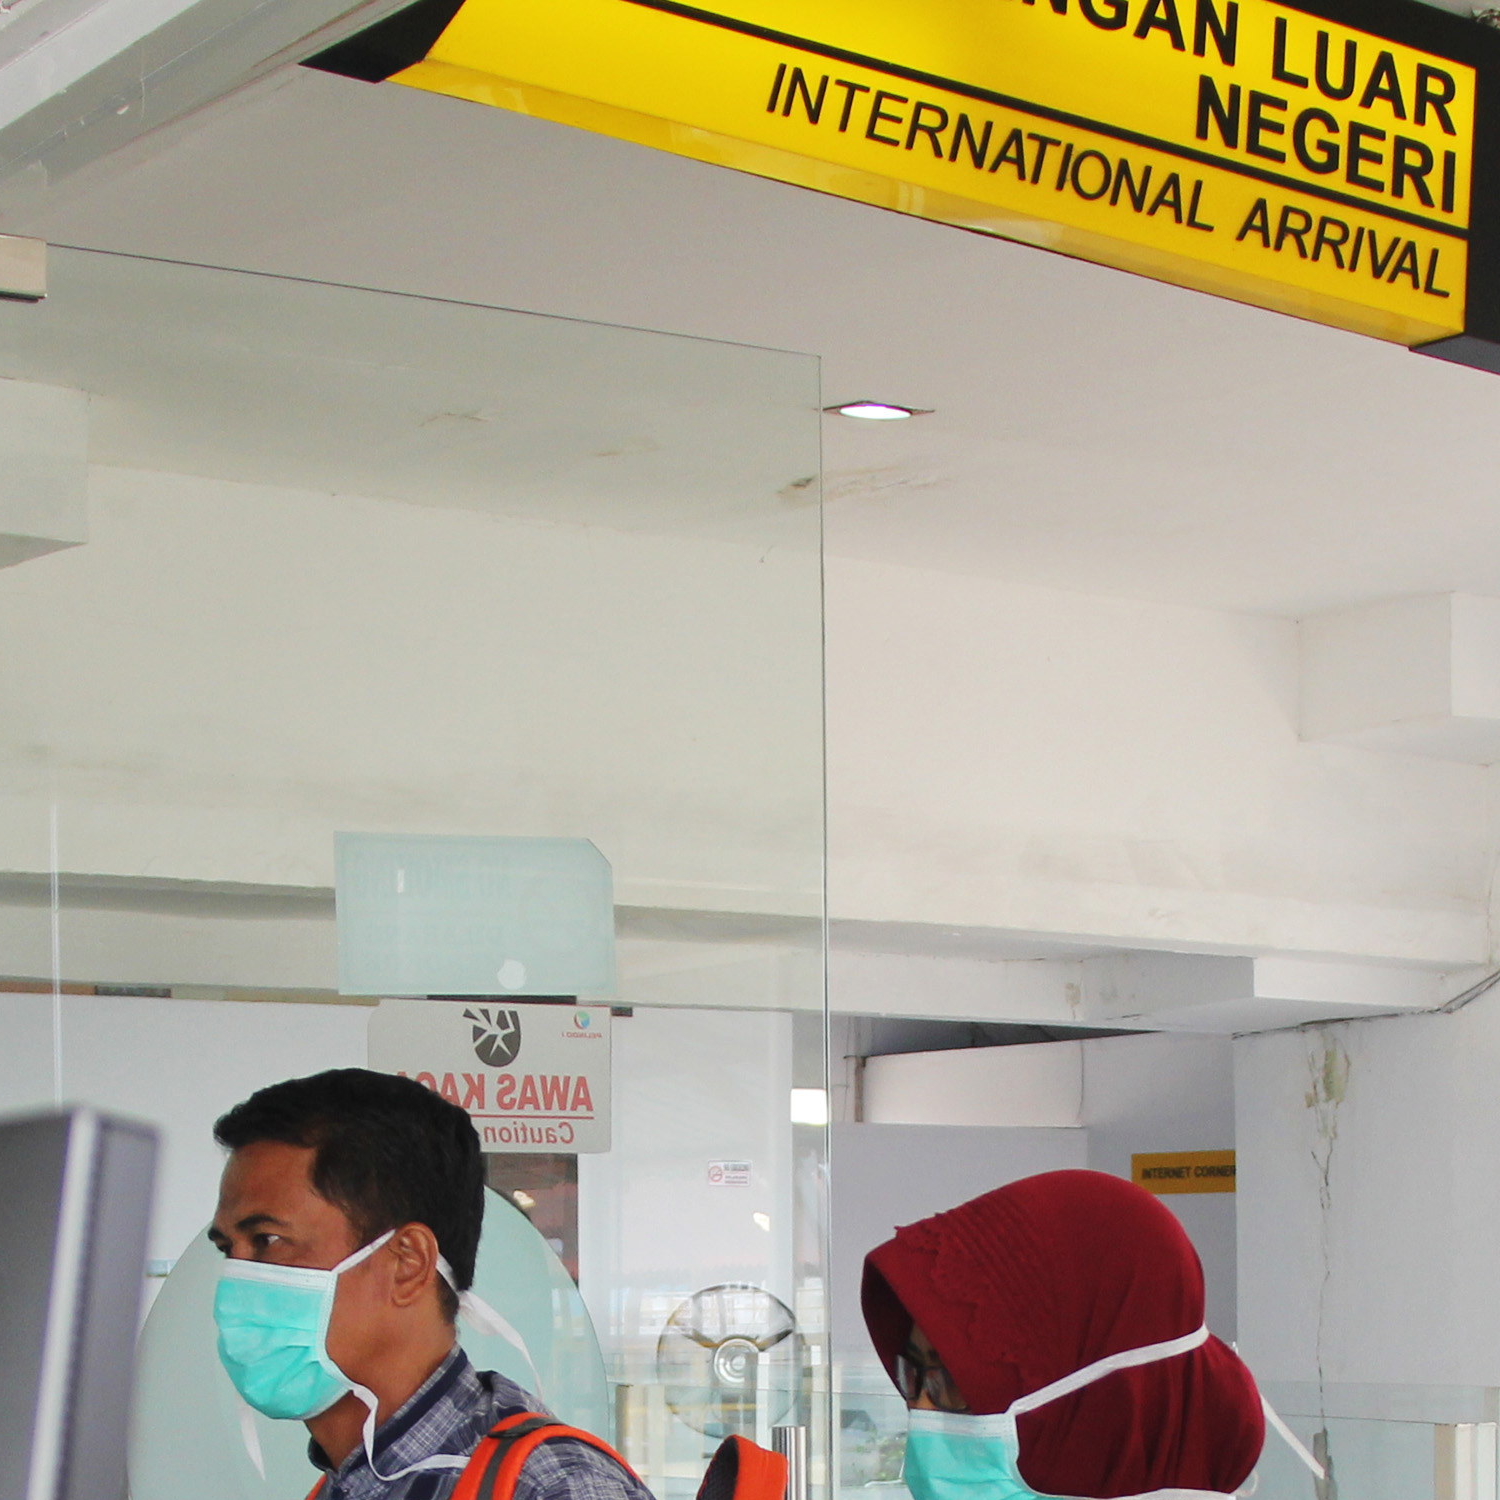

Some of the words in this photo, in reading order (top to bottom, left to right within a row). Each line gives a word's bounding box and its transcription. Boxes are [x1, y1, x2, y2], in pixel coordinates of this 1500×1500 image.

[1271, 16, 1457, 136] LUAR
[765, 63, 1215, 232] INTERNATIONAL
[1235, 198, 1450, 298] ARRIVAL
[1196, 74, 1456, 213] NEGERI
[1142, 1166, 1191, 1179] INTERNET
